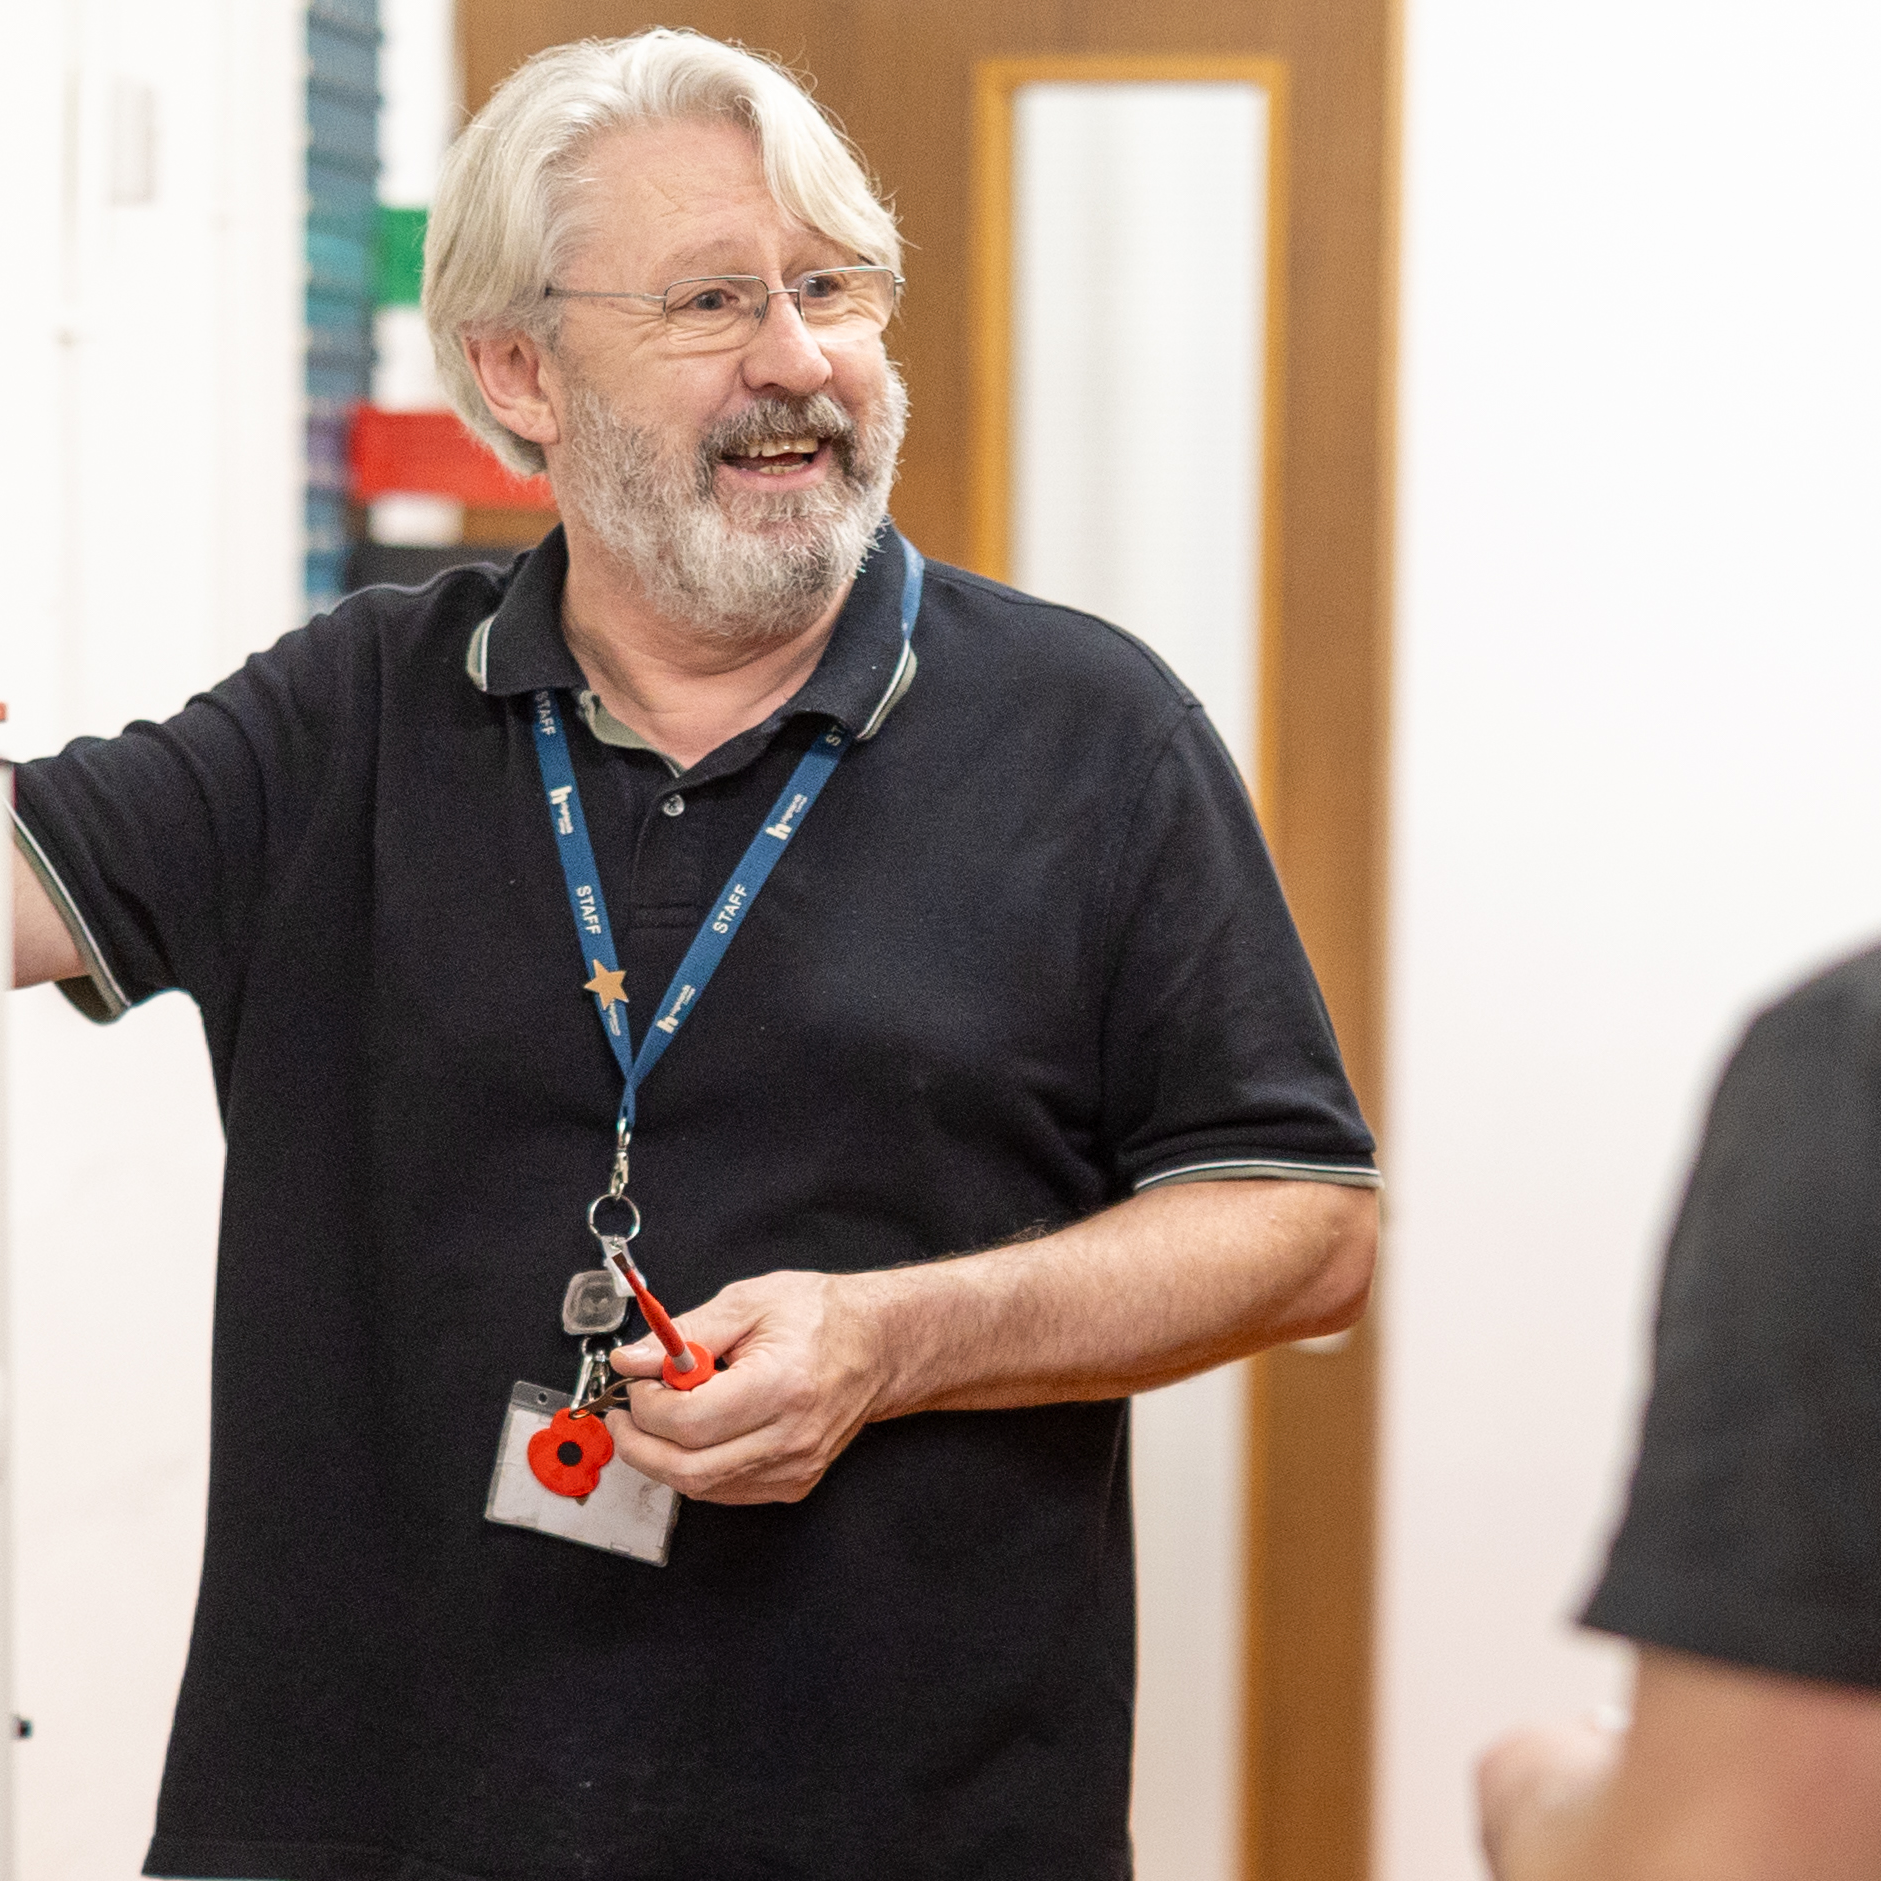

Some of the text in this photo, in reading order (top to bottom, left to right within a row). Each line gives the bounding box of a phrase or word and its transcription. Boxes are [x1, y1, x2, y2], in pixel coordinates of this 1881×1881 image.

[534, 691, 557, 737] STAFF
[575, 885, 602, 936] STAFF
[712, 883, 749, 935] STAFF
